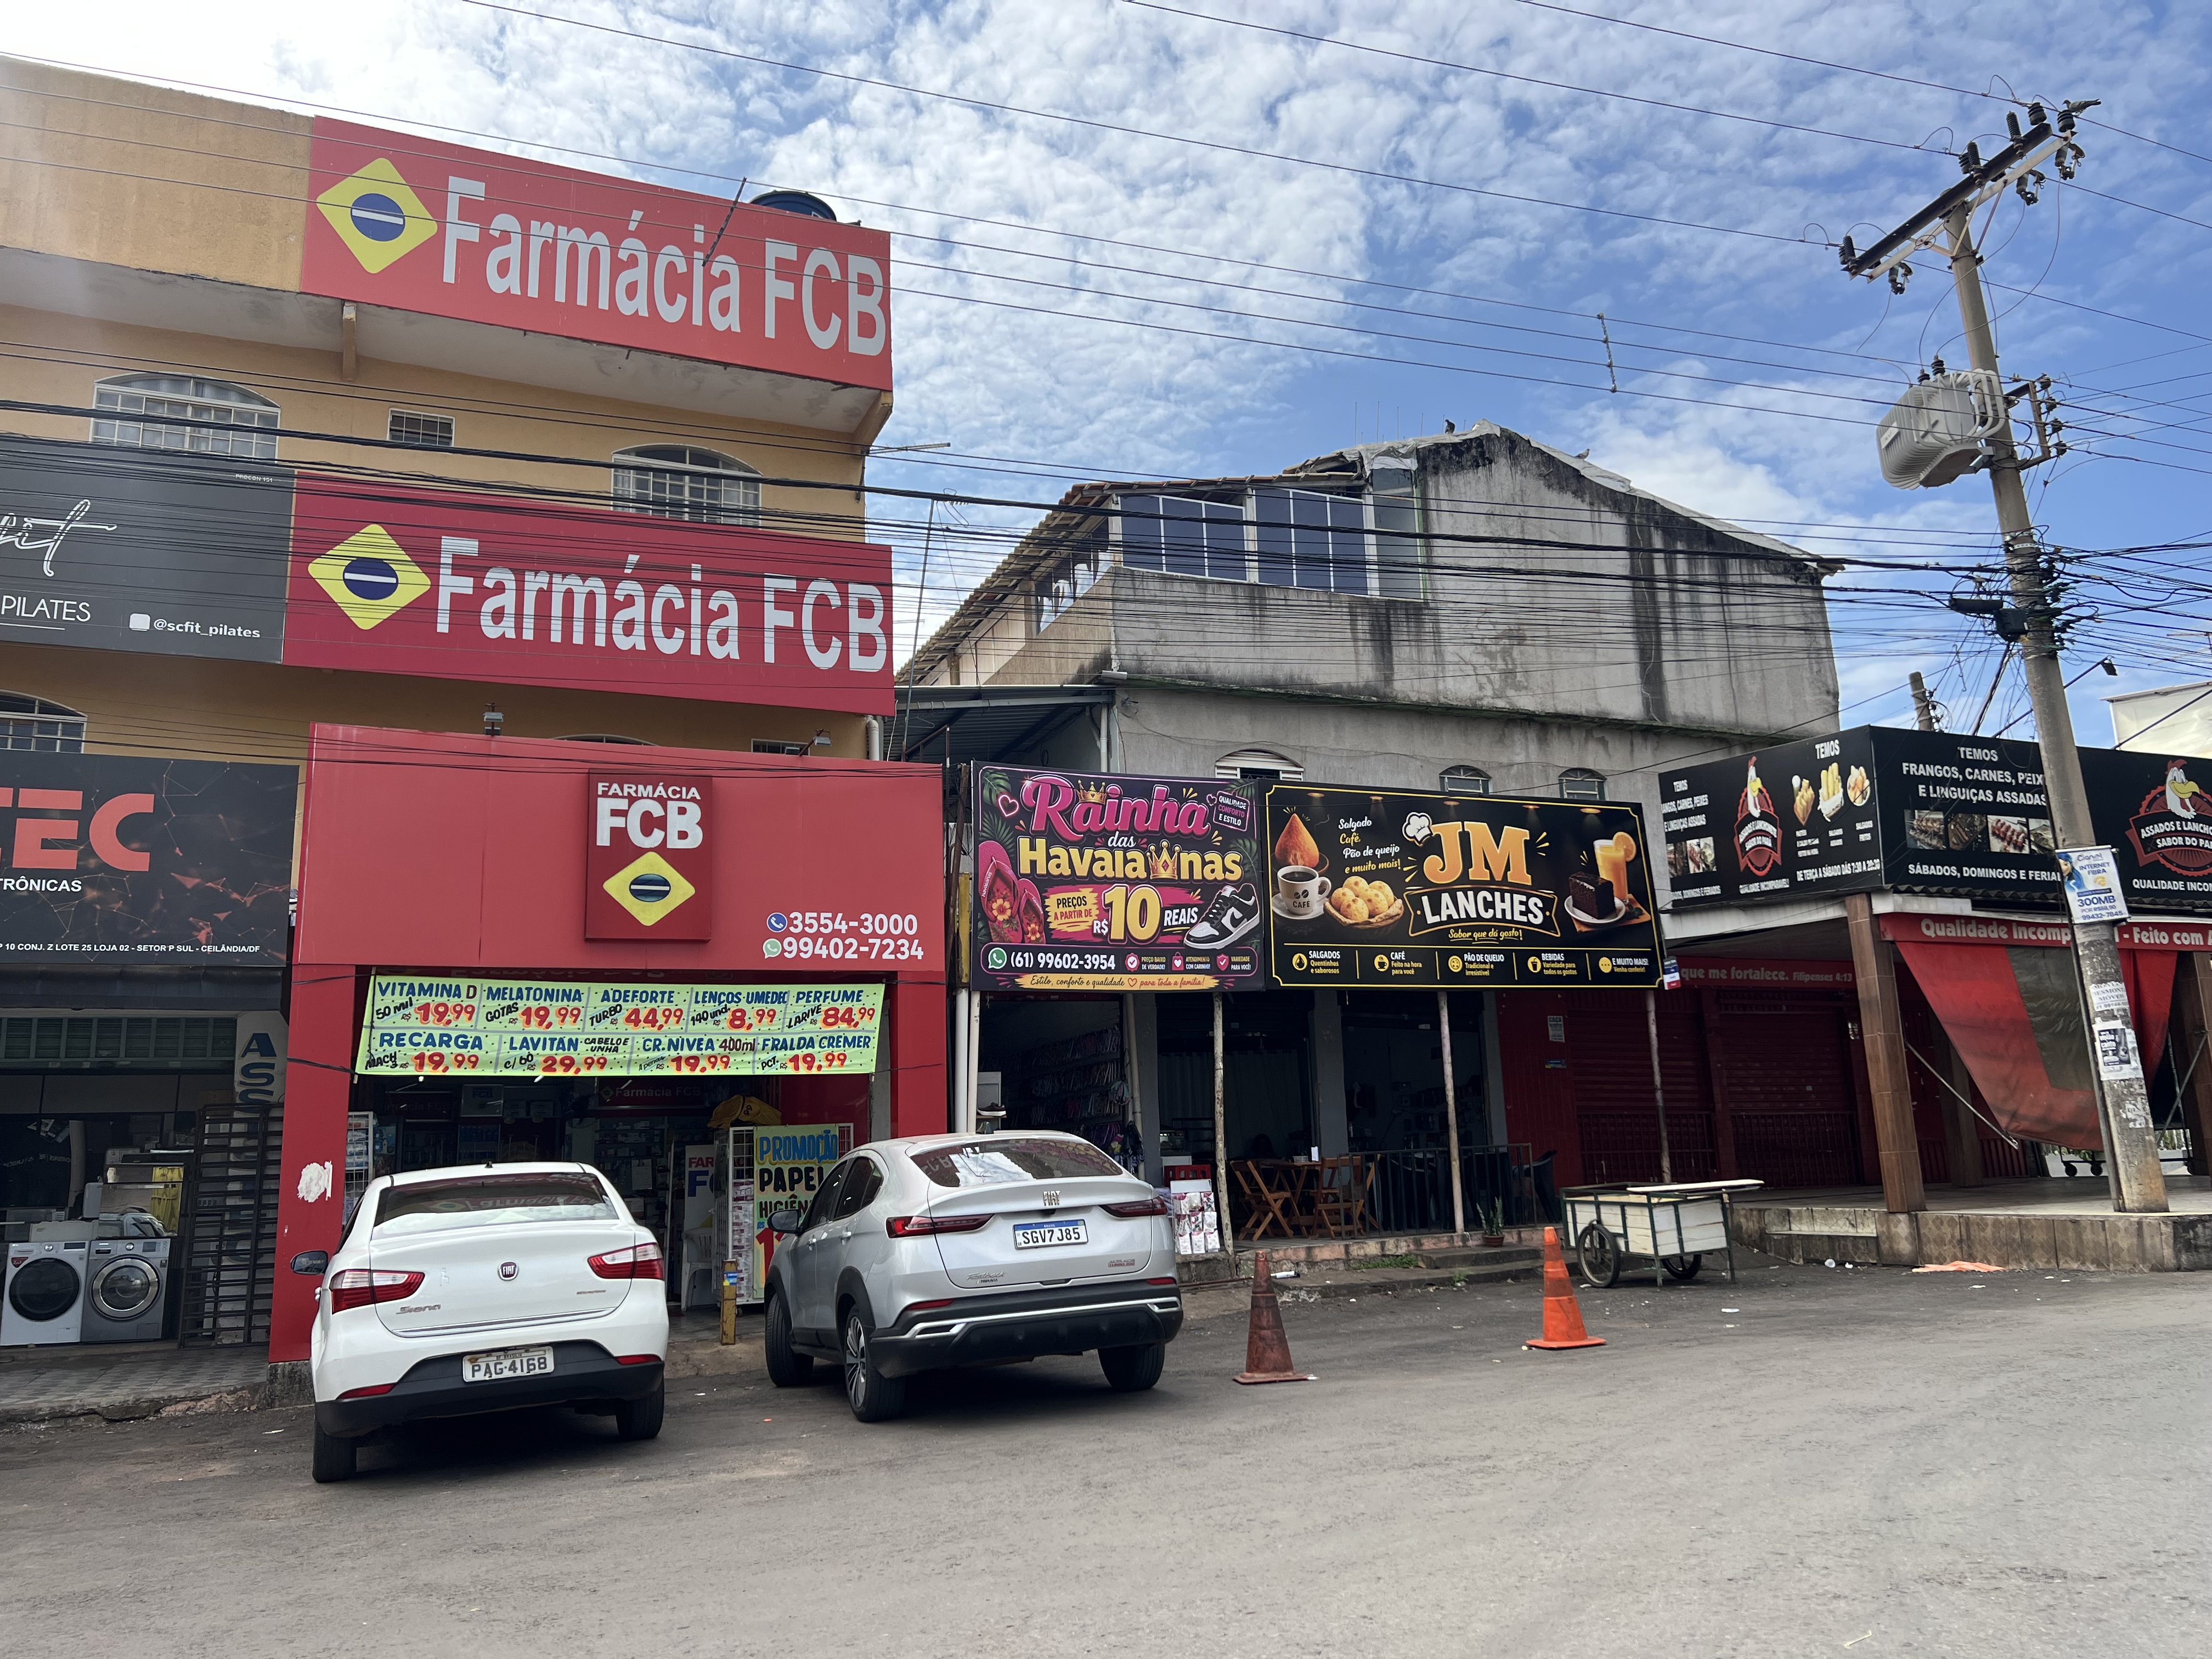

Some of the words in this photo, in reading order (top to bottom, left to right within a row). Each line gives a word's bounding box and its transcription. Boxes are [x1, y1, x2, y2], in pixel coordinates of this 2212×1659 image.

[443, 175, 741, 334] Farmácia
[764, 237, 886, 357] FCB
[1, 595, 91, 622] PILATES
[437, 535, 740, 659] Farmácia
[763, 572, 885, 673] FCB
[153, 618, 261, 639] @scfit_pilates
[1815, 739, 1841, 759] TEMOS
[1957, 747, 1999, 762] TEMOS
[1901, 762, 1963, 781] FRANGOS,
[1965, 768, 2016, 786] CARNES,
[597, 782, 701, 800] FARMÁCIA
[1918, 785, 1927, 797] E
[1929, 785, 1994, 803] LINGUIÇAS
[1996, 790, 2047, 806] ASSADAS
[1021, 774, 1211, 843] Rainha
[1218, 795, 1247, 810] QUALIDADE
[1218, 804, 1245, 819] CONFORTO
[596, 797, 704, 849] FCB
[1223, 814, 1242, 827] ESTILO
[1338, 816, 1373, 832] Salgado
[2141, 821, 2176, 839] ASSADOS
[2175, 821, 2182, 831] E
[1107, 830, 1137, 848] das
[2155, 837, 2184, 848] SABOR
[2185, 837, 2198, 846] DO
[1342, 847, 1361, 860] Pão
[1362, 845, 1373, 857] de
[1375, 843, 1400, 859] queijo
[1423, 820, 1533, 887] JM
[1345, 866, 1350, 874] e
[1352, 860, 1376, 873] muito
[1378, 858, 1401, 870] mais!
[1908, 862, 1961, 878] SÁBADOS,
[1962, 866, 2017, 879] DOMINGOS
[2019, 870, 2027, 879] E
[2079, 862, 2111, 871] INTERNET
[2132, 878, 2186, 891] QUALIDADE
[1056, 895, 1087, 910] PREÇOS
[1293, 899, 1310, 909] CAFÉ
[1421, 890, 1544, 926] LANCHES
[2076, 895, 2116, 907] 300MB
[1054, 912, 1059, 921] A
[1059, 910, 1084, 921] PARTIR
[1084, 909, 1093, 917] DE
[1093, 918, 1109, 935] R$
[1103, 885, 1161, 942] 10
[1163, 906, 1199, 927] REAIS
[788, 911, 918, 935] 3554-3000
[1448, 928, 1472, 939] Sabor
[1472, 929, 1487, 941] que
[1488, 927, 1498, 938] dá
[1499, 927, 1523, 941] gosto!
[1921, 918, 2008, 943] Qualidade
[2132, 926, 2169, 945] Feito
[2172, 932, 2204, 946] com
[201, 944, 261, 953] CEILÂNDIA/DF
[783, 937, 924, 960] 99402-7234
[1308, 950, 1341, 959] SALGADOS
[1390, 951, 1406, 960] CAFÉ
[1541, 953, 1565, 961] BEBIDAS
[1011, 951, 1034, 968] (61)
[1037, 953, 1116, 970] 99602-3954
[1464, 953, 1475, 962] PÃO
[1484, 954, 1504, 963] QUEIJO
[1030, 975, 1054, 986] Estilo,
[1056, 977, 1085, 988] conforto
[1092, 977, 1125, 989] qualidade
[1139, 979, 1156, 989] para
[1158, 978, 1172, 986] toda
[1180, 977, 1205, 988] família!
[1680, 967, 1705, 981] que
[1708, 967, 1728, 979] me
[1730, 966, 1789, 981] fortalece.
[1792, 972, 1833, 983] Filipenses
[1835, 973, 1853, 983] 4:13
[377, 981, 462, 999] VITAMINA
[466, 984, 477, 999] D
[486, 986, 582, 1003] MELATONINA
[601, 989, 675, 1003] ADEFORTE
[694, 991, 742, 1006] LENÇOS
[795, 990, 864, 1003] PERFUME
[375, 1006, 391, 1020] 50
[414, 1001, 476, 1027] 19,99
[486, 1002, 519, 1023] GOTAS
[518, 1006, 582, 1030] 19,99
[589, 1003, 622, 1026] TURBO
[623, 1008, 684, 1031] 44,99
[690, 1010, 709, 1026] 140
[727, 1008, 777, 1031] 8,99
[787, 1003, 822, 1029] LARIVE
[820, 1006, 876, 1029] 84,99
[379, 1031, 483, 1051] RECARGA
[509, 1036, 579, 1052] LAVITAN
[584, 1037, 622, 1046] CABELO
[761, 1036, 815, 1051] FRALDA
[819, 1035, 871, 1048] CREMER
[365, 1051, 397, 1070] MACH
[411, 1051, 479, 1074] 19,99
[504, 1057, 517, 1069] c/
[519, 1053, 534, 1065] 60
[540, 1055, 608, 1075] 29,99
[614, 1087, 672, 1098] Farmácia
[675, 1086, 702, 1097] FCB
[758, 1130, 838, 1164] PROMOÇÃO
[1042, 1190, 1061, 1206] FIAT
[1022, 1226, 1081, 1245] SGV7J85
[502, 1265, 515, 1276] FIAT
[966, 1270, 1006, 1280] Fastback
[396, 1304, 442, 1314] Siena
